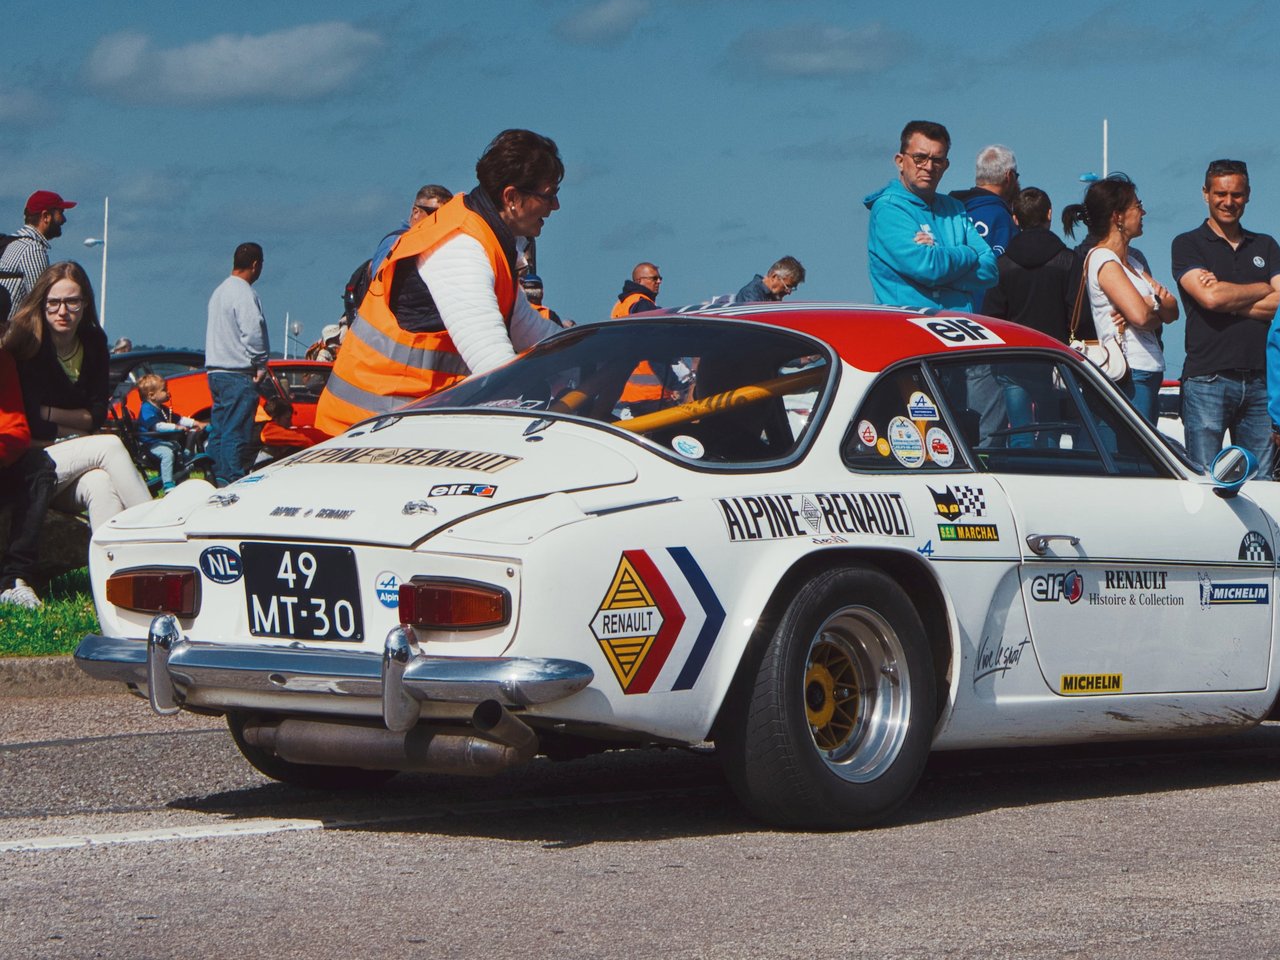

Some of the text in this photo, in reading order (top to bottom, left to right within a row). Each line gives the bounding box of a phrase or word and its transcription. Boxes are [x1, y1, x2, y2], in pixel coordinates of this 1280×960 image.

[926, 319, 989, 342] elf
[387, 448, 520, 472] RENAULT
[430, 484, 472, 497] elf
[718, 493, 910, 541] ALPINE RENAULT
[956, 526, 998, 540] MARCHAL
[206, 553, 239, 577] NL
[276, 551, 318, 590] 49
[1031, 572, 1066, 602] elf
[1105, 570, 1168, 590] RENAULT
[379, 591, 399, 603] Alpin
[1089, 592, 1185, 606] Histoire & Collection
[1213, 587, 1268, 599] MICHELIN
[602, 612, 653, 635] RENAULT
[1063, 675, 1121, 691] MICHELIN
